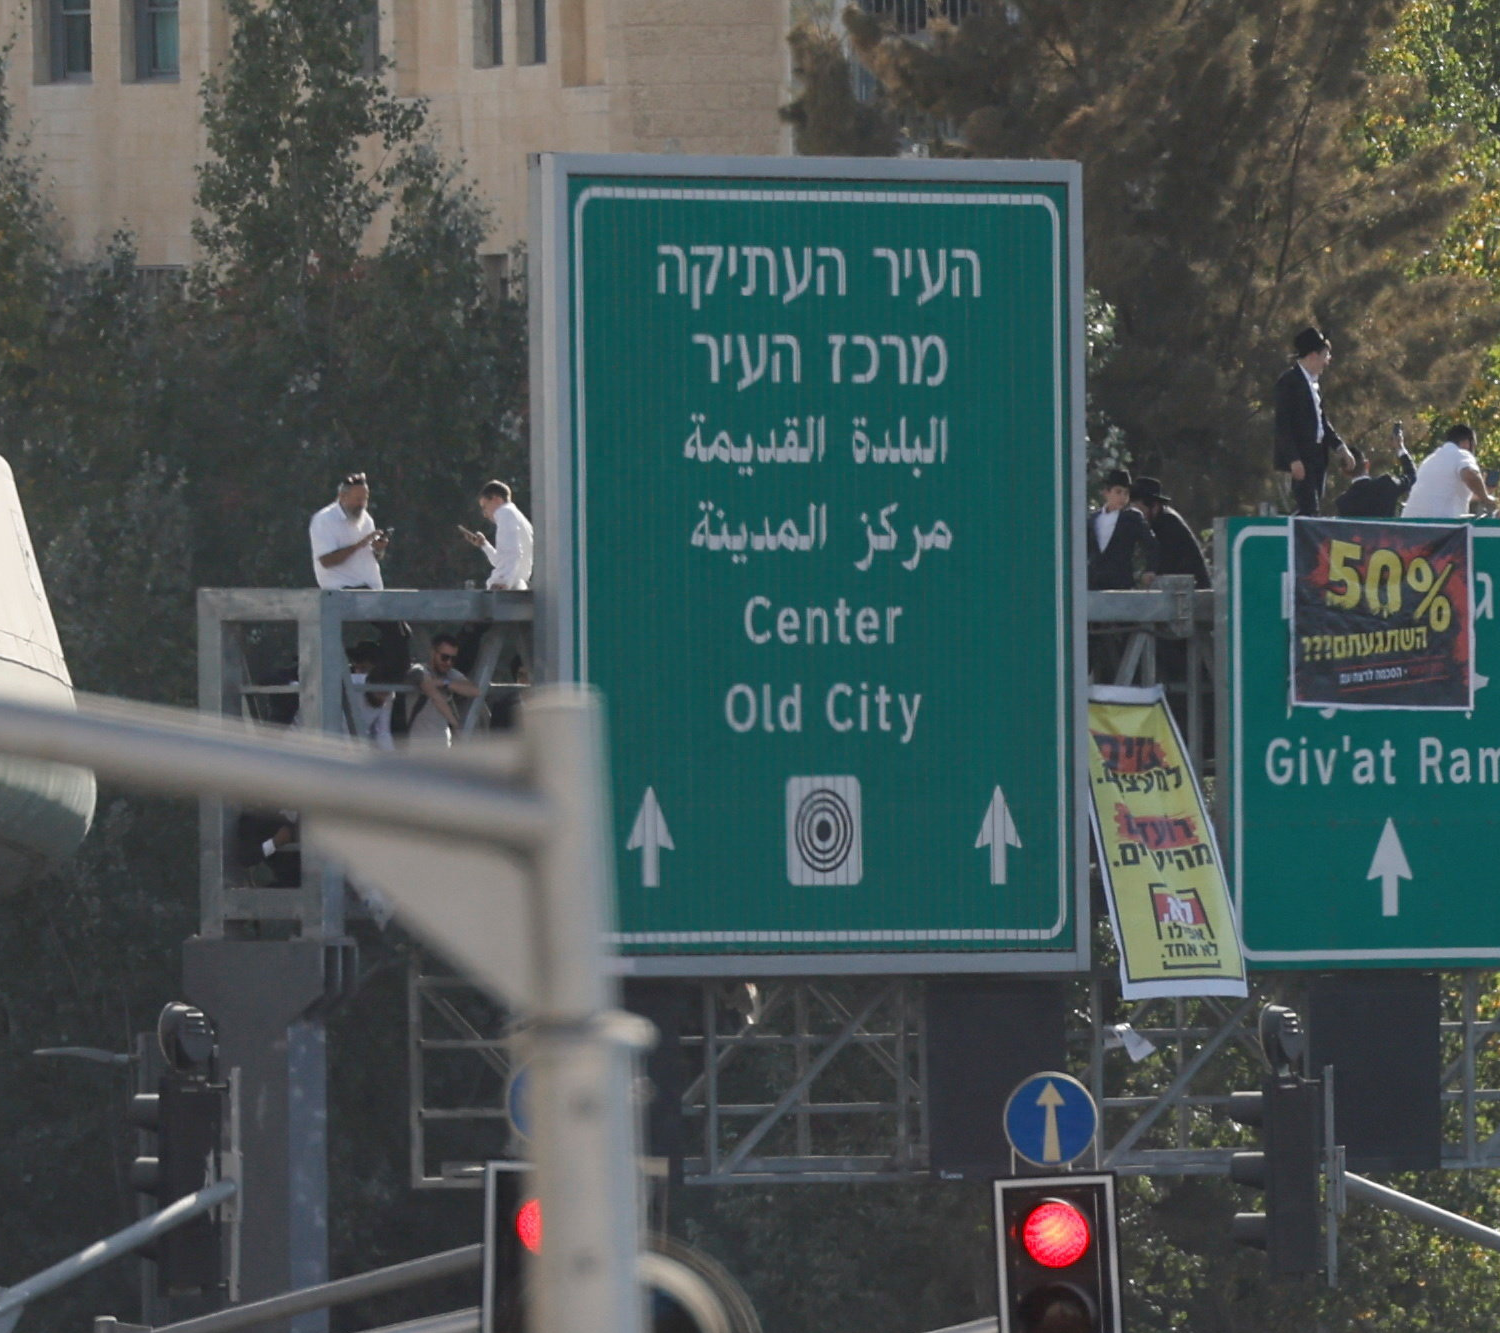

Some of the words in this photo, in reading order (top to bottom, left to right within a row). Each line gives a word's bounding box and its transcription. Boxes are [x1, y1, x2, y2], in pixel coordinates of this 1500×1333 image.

[657, 245, 847, 310] העתיקה
[873, 246, 982, 306] העיר
[691, 334, 801, 392] העיר
[827, 334, 949, 387] מרכז
[683, 413, 826, 476] القديمة
[852, 414, 949, 478] البلدة
[690, 502, 827, 564] المدينة
[853, 502, 954, 571] مركز
[1326, 539, 1454, 632] 50%
[743, 596, 903, 645] Center
[1301, 626, 1427, 662] השתגעתם???
[724, 683, 803, 733] Old
[825, 682, 922, 744] City
[1266, 735, 1396, 785] Giv'at
